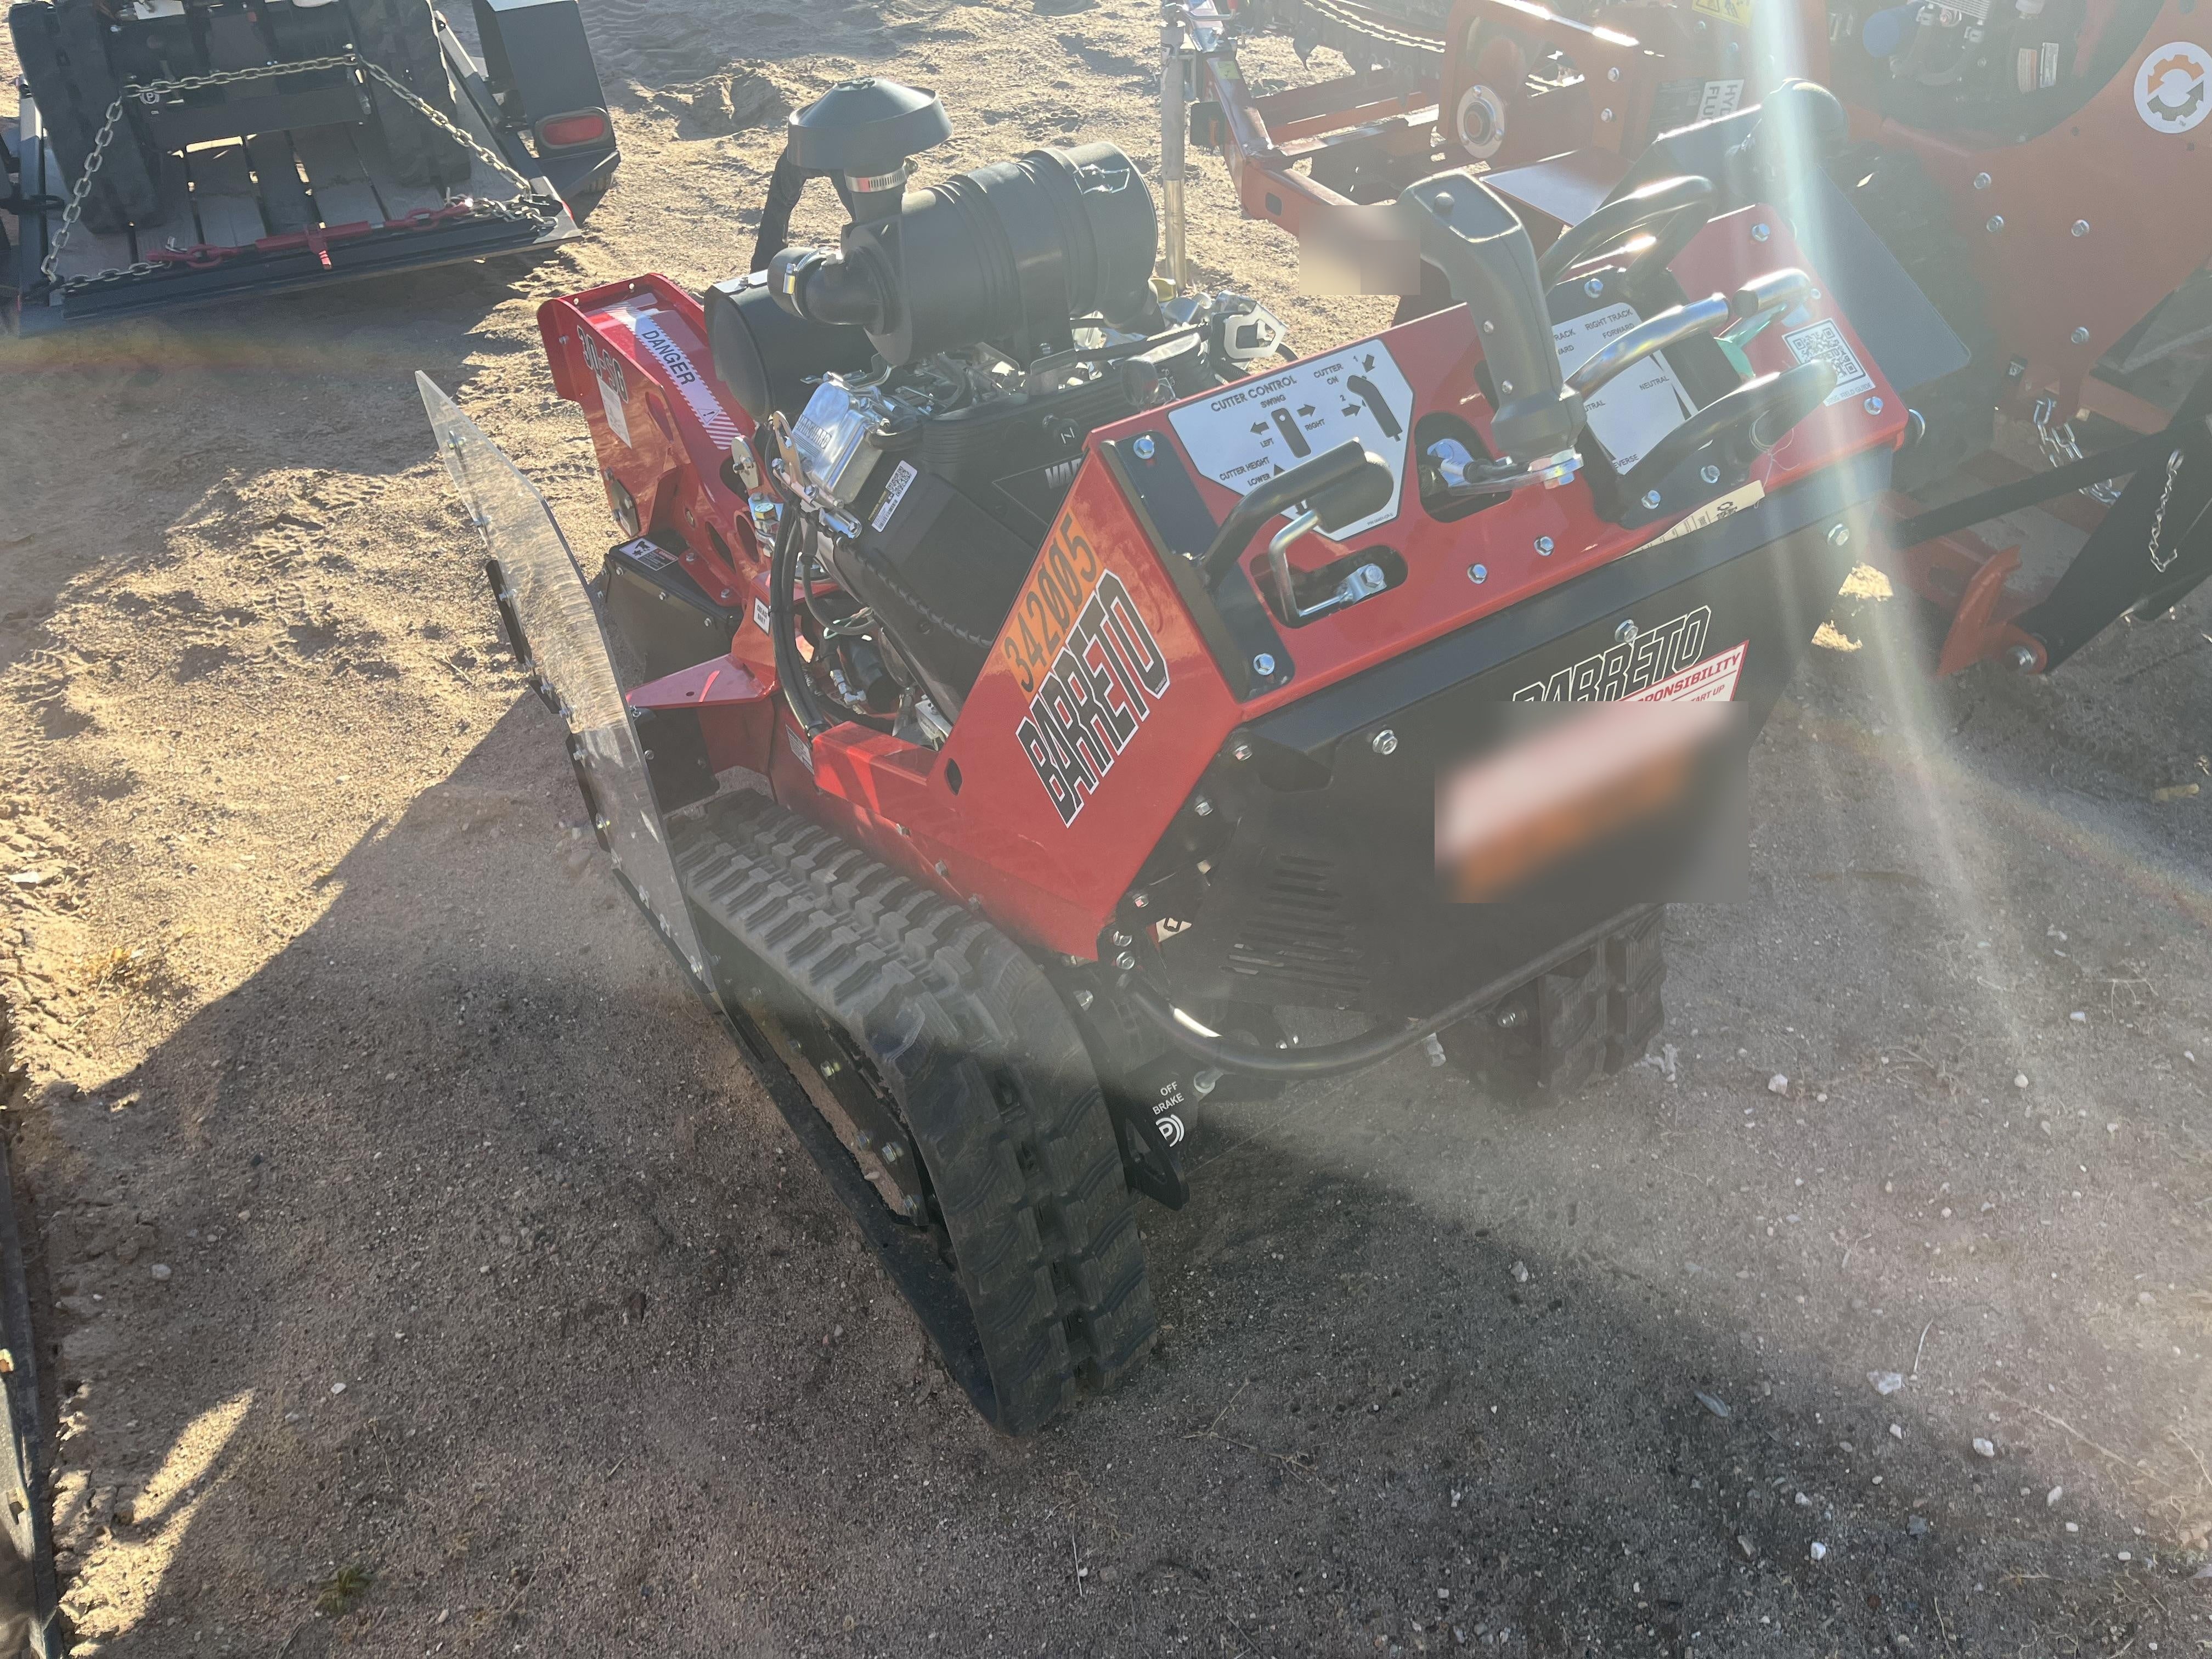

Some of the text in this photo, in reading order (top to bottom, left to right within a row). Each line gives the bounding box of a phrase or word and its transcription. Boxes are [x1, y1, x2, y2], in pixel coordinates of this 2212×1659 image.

[1584, 308, 1633, 331] RIGHT TRACK
[1553, 329, 1576, 341] RACK
[1602, 323, 1635, 339] FORWARD
[641, 330, 696, 385] DANGER
[1313, 363, 1344, 379] CUTTER
[1327, 376, 1339, 385] ON
[1639, 375, 1670, 391] NEUTRAL
[1210, 375, 1298, 412] CUTTER CONTROL
[1260, 394, 1286, 409] SWING
[1304, 419, 1326, 431] RIGHT
[1260, 438, 1274, 448] LEFT
[1219, 456, 1270, 481] CUTTER HEIGHT
[1612, 454, 1640, 469] EVERSE
[1247, 473, 1272, 487] LOWER
[1003, 514, 1097, 693] 342005
[1638, 652, 1741, 702] PONSIBILITY
[1713, 685, 1725, 695] UP
[1015, 568, 1170, 829] BARRETO
[1160, 1081, 1178, 1096] OFF
[1152, 1092, 1184, 1115] BRAKE
